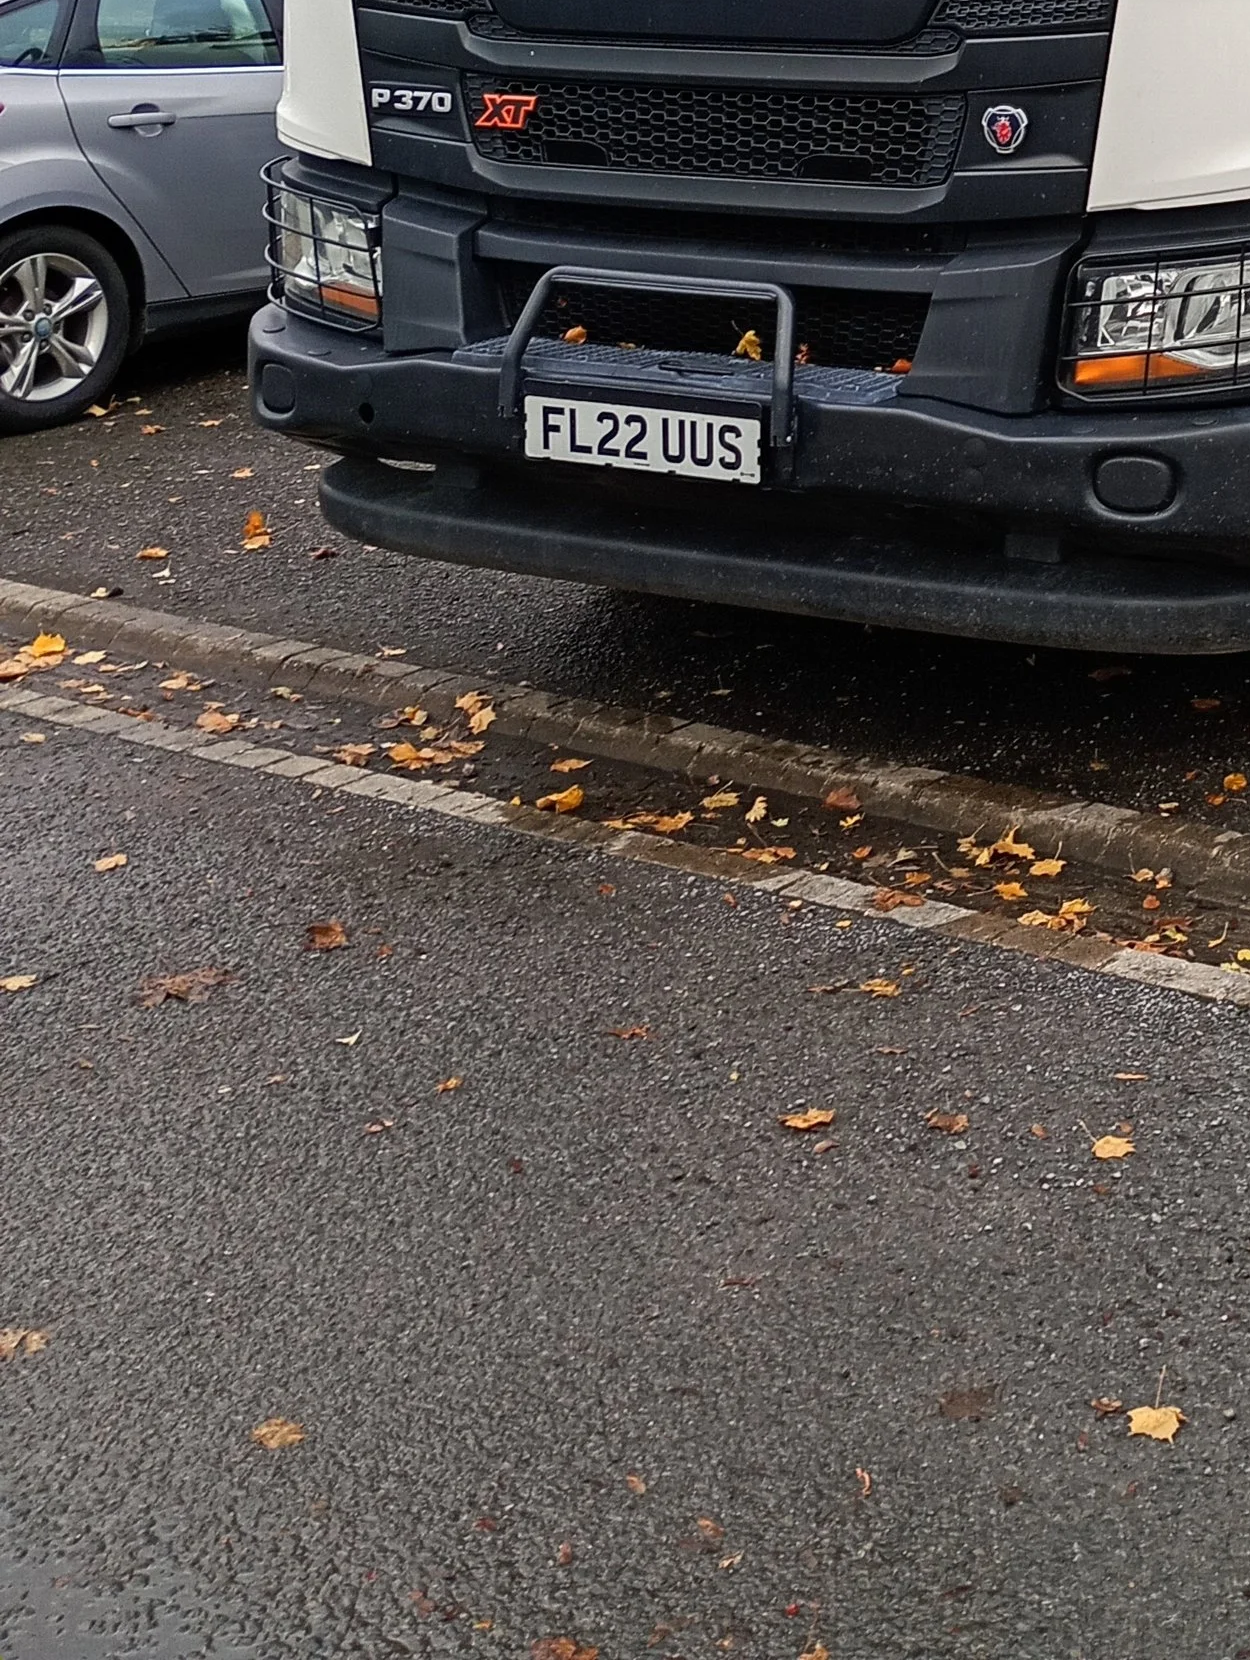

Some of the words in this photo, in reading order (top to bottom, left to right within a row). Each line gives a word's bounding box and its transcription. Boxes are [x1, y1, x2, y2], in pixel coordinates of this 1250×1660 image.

[474, 94, 538, 128] XT
[542, 405, 649, 461] FL22
[661, 417, 743, 471] UUS
